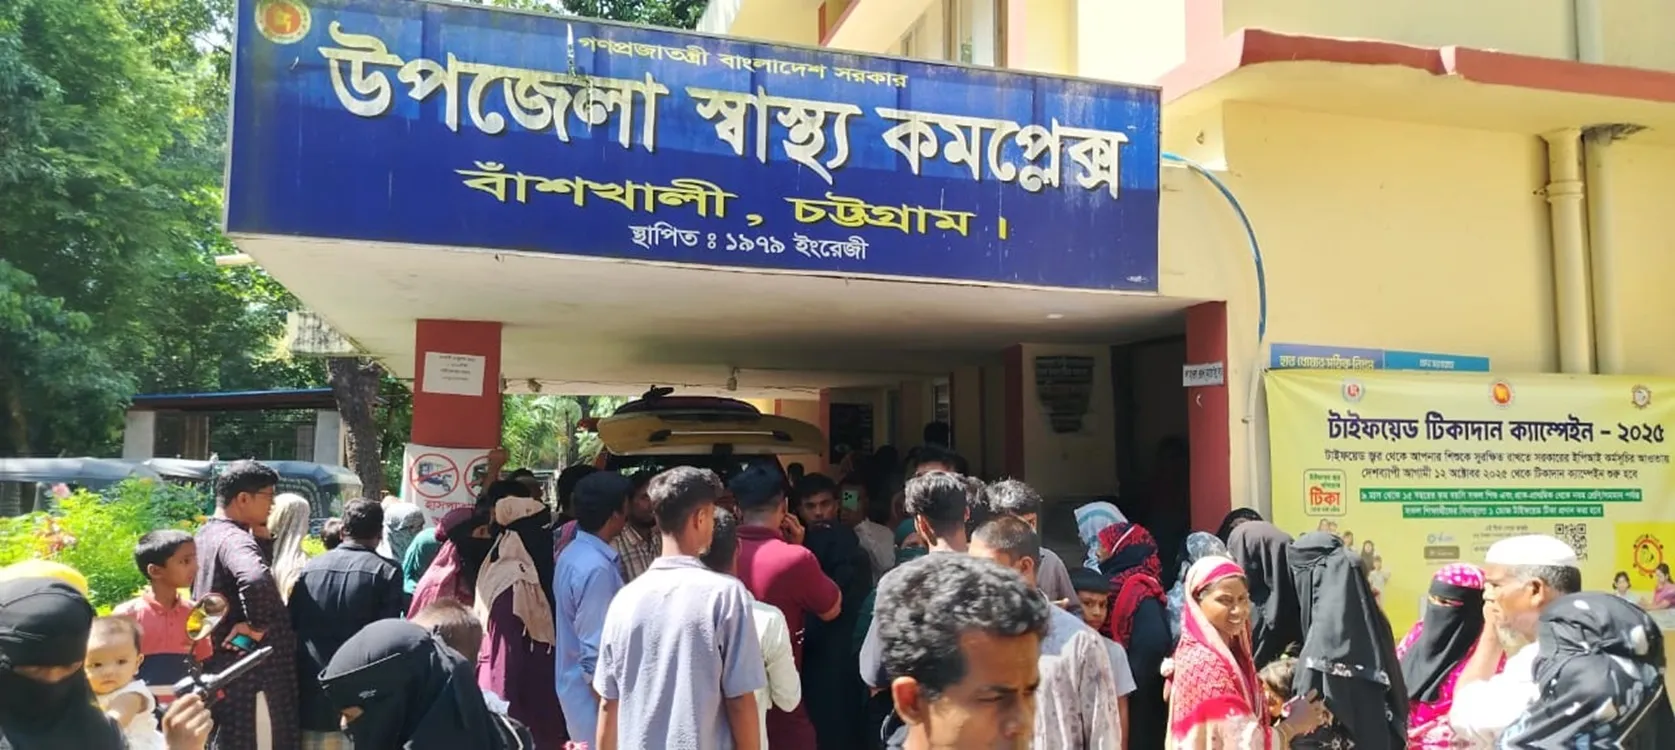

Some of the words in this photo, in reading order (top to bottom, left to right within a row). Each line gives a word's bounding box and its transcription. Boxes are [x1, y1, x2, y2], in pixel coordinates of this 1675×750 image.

[717, 53, 827, 79] বাংলাদেশ
[833, 66, 908, 88] সরকার
[318, 20, 669, 152] উপজেলা
[685, 84, 862, 185] স্বাস্থ্য
[874, 106, 1129, 199] কমপ্লেক্স
[454, 160, 738, 218] বাঁশখালী
[783, 191, 977, 237] চট্টগ্রাম
[628, 221, 699, 250] স্থাপিত
[725, 234, 785, 255] ১৯৭৯
[793, 232, 869, 260] ইংরেজী
[1328, 409, 1418, 441] টাইফয়েড
[1425, 411, 1502, 441] টিকাদান
[1509, 414, 1593, 442] ক্যাম্পেইন
[1617, 423, 1664, 442] ২০২৫
[1325, 448, 1365, 462] টাইফয়েড
[1385, 451, 1409, 462] থেকে
[1410, 451, 1442, 462] আপনার
[1444, 449, 1472, 463] শিশুকে
[1474, 449, 1503, 464] সুরক্ষিত
[1534, 452, 1569, 463] সরকারের
[1572, 450, 1601, 463] ইপিআই
[1361, 465, 1400, 479] দেশব্যাপী
[1402, 465, 1432, 479] আগামী
[1434, 469, 1446, 479] ১২
[1449, 467, 1480, 479] অক্টোবর
[1483, 469, 1507, 480] ২০২৫
[1511, 468, 1531, 479] থেকে
[1533, 466, 1564, 479] টিকাদান
[1567, 467, 1604, 479] ক্যাম্পেইন
[1623, 469, 1638, 479] হবে
[1309, 486, 1341, 506] টিকা
